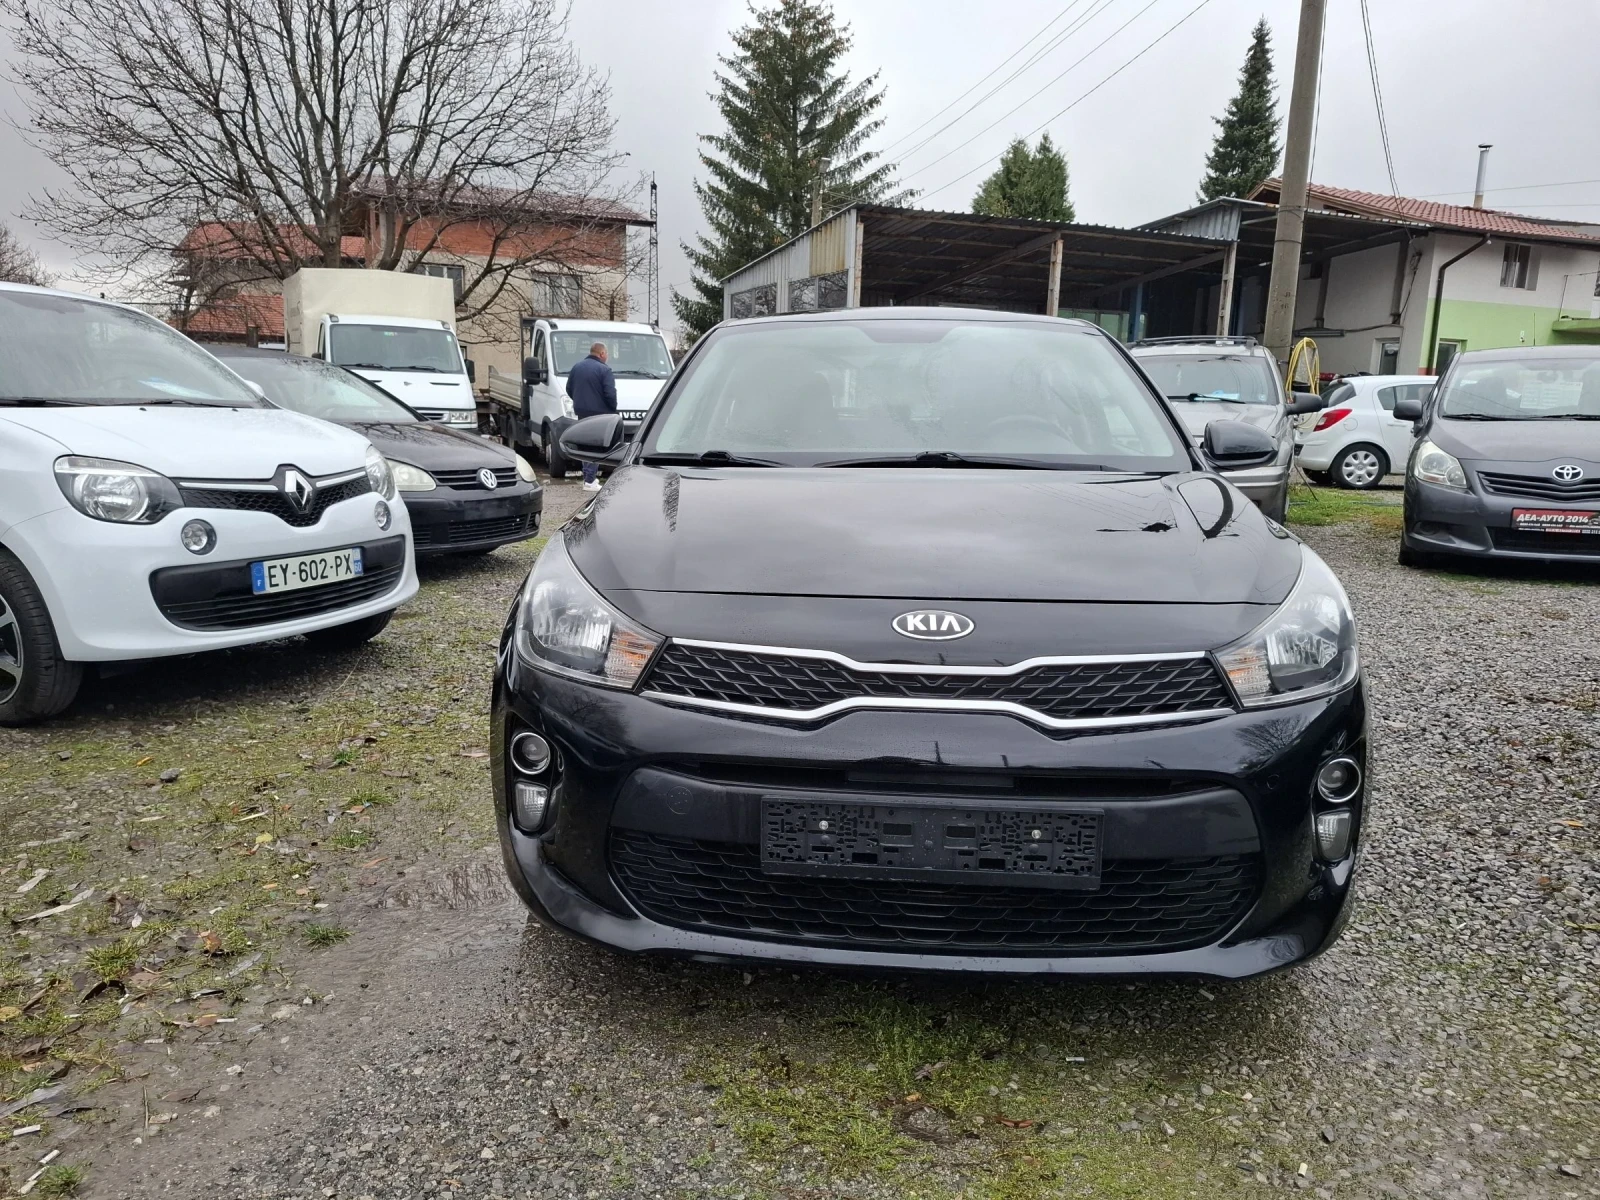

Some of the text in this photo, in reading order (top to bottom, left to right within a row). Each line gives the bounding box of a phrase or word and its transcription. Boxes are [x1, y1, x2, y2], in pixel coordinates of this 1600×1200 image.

[1565, 515, 1589, 523] 2014
[267, 553, 352, 588] EY-602-PX
[906, 614, 961, 632] KIA
